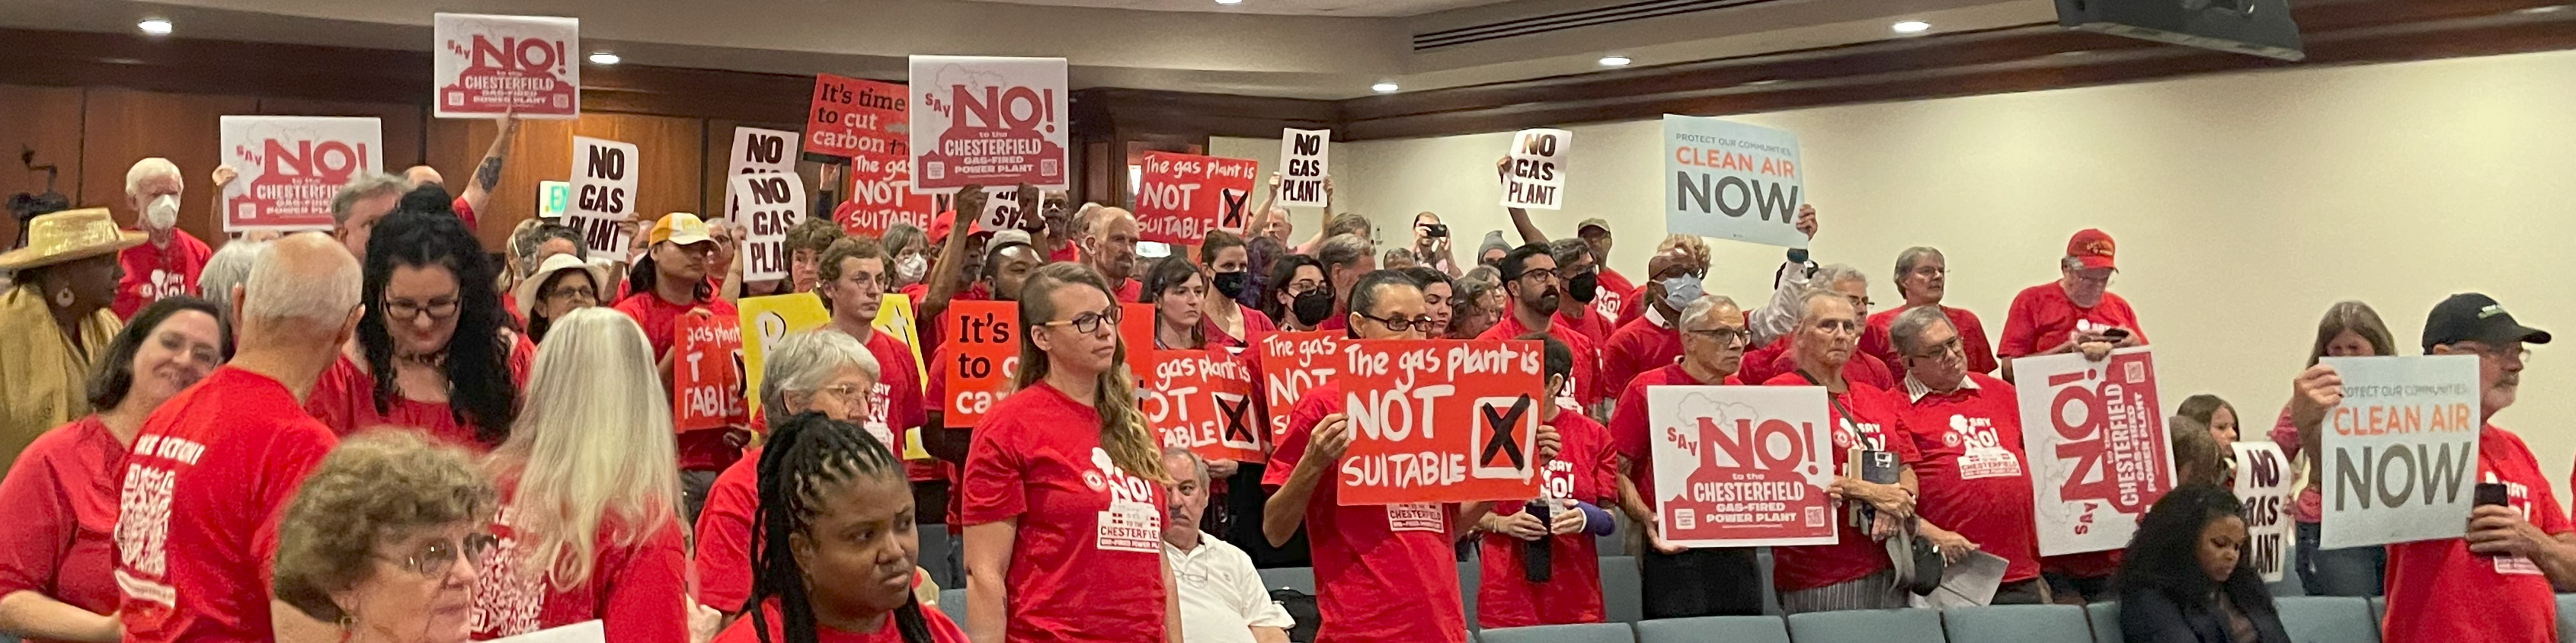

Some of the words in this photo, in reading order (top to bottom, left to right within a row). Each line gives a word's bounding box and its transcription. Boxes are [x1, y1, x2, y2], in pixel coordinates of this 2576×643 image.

[447, 40, 471, 59] SAY
[472, 34, 566, 75] NO!
[465, 75, 555, 91] CHESTERFIELD
[821, 83, 853, 104] It's
[859, 88, 906, 112] time
[925, 93, 951, 117] SAY
[952, 85, 1054, 133] NO!
[818, 107, 838, 123] to
[844, 113, 878, 131] cut
[747, 133, 783, 164] NO
[813, 130, 885, 153] carbon
[945, 138, 1042, 157] CHESTERFIELD
[1294, 133, 1320, 155] NO
[1522, 133, 1557, 157] NO
[1676, 133, 1716, 144] PROTECT
[1718, 138, 1736, 147] OUR
[264, 139, 367, 178] NO!
[588, 145, 625, 181] NO
[855, 155, 879, 173] The
[954, 165, 995, 174] POWER
[997, 164, 1034, 173] PLANT
[963, 155, 1024, 165] GAS-FIRED
[1145, 155, 1170, 174] The
[1174, 161, 1202, 179] gas
[1206, 160, 1241, 179] plant
[1243, 162, 1255, 180] is
[1289, 158, 1320, 176] GAS
[1515, 158, 1554, 181] GAS
[1676, 146, 1753, 172] CLEAN
[1761, 157, 1795, 178] AIR
[257, 184, 338, 200] CHESTERFIE
[579, 184, 624, 213] GAS
[748, 177, 791, 205] NO
[854, 179, 910, 207] NOT
[1143, 182, 1201, 210] NOT
[1283, 179, 1321, 202] PLANT
[1509, 181, 1556, 205] PLANT
[1678, 171, 1798, 224] NOW
[753, 210, 795, 235] GAS
[1137, 214, 1214, 240] SUITABLE
[750, 242, 782, 274] PLA
[959, 312, 1010, 343] It's
[1263, 334, 1294, 357] The
[1300, 335, 1336, 367] gas
[958, 353, 990, 378] to
[1155, 357, 1195, 392] gas
[1199, 354, 1237, 382] plant
[1237, 361, 1250, 382] is
[1344, 344, 1389, 377] The
[1395, 347, 1441, 393] gas
[1448, 343, 1518, 382] plant
[1521, 344, 1539, 375] is
[685, 383, 743, 420] TABLE
[1150, 387, 1198, 423] OT
[2381, 385, 2402, 397] OUR
[1347, 385, 1455, 441] NOT
[2333, 405, 2421, 436] CLEAN
[2429, 403, 2470, 433] AIR
[1159, 421, 1218, 448] ABLE
[1667, 427, 1698, 456] SAY
[1696, 417, 1819, 475] NO!
[2048, 369, 2102, 502] NO!
[2104, 383, 2139, 506] CHESTERFIELD
[1342, 451, 1466, 488] SUITABLE
[1548, 460, 1573, 473] SAY
[1746, 472, 1765, 481] the
[2247, 449, 2280, 488] NO
[2335, 442, 2471, 511] NOW
[1108, 475, 1154, 504] NO!
[1694, 481, 1804, 502] CHESTERFIELD
[1706, 513, 1753, 523] POWER
[1755, 512, 1797, 523] PLANT
[1716, 503, 1786, 512] GAS-FIRED
[2075, 502, 2098, 535] SAY
[1100, 526, 1157, 539] CHESTERFIE
[2255, 533, 2280, 574] ANT
